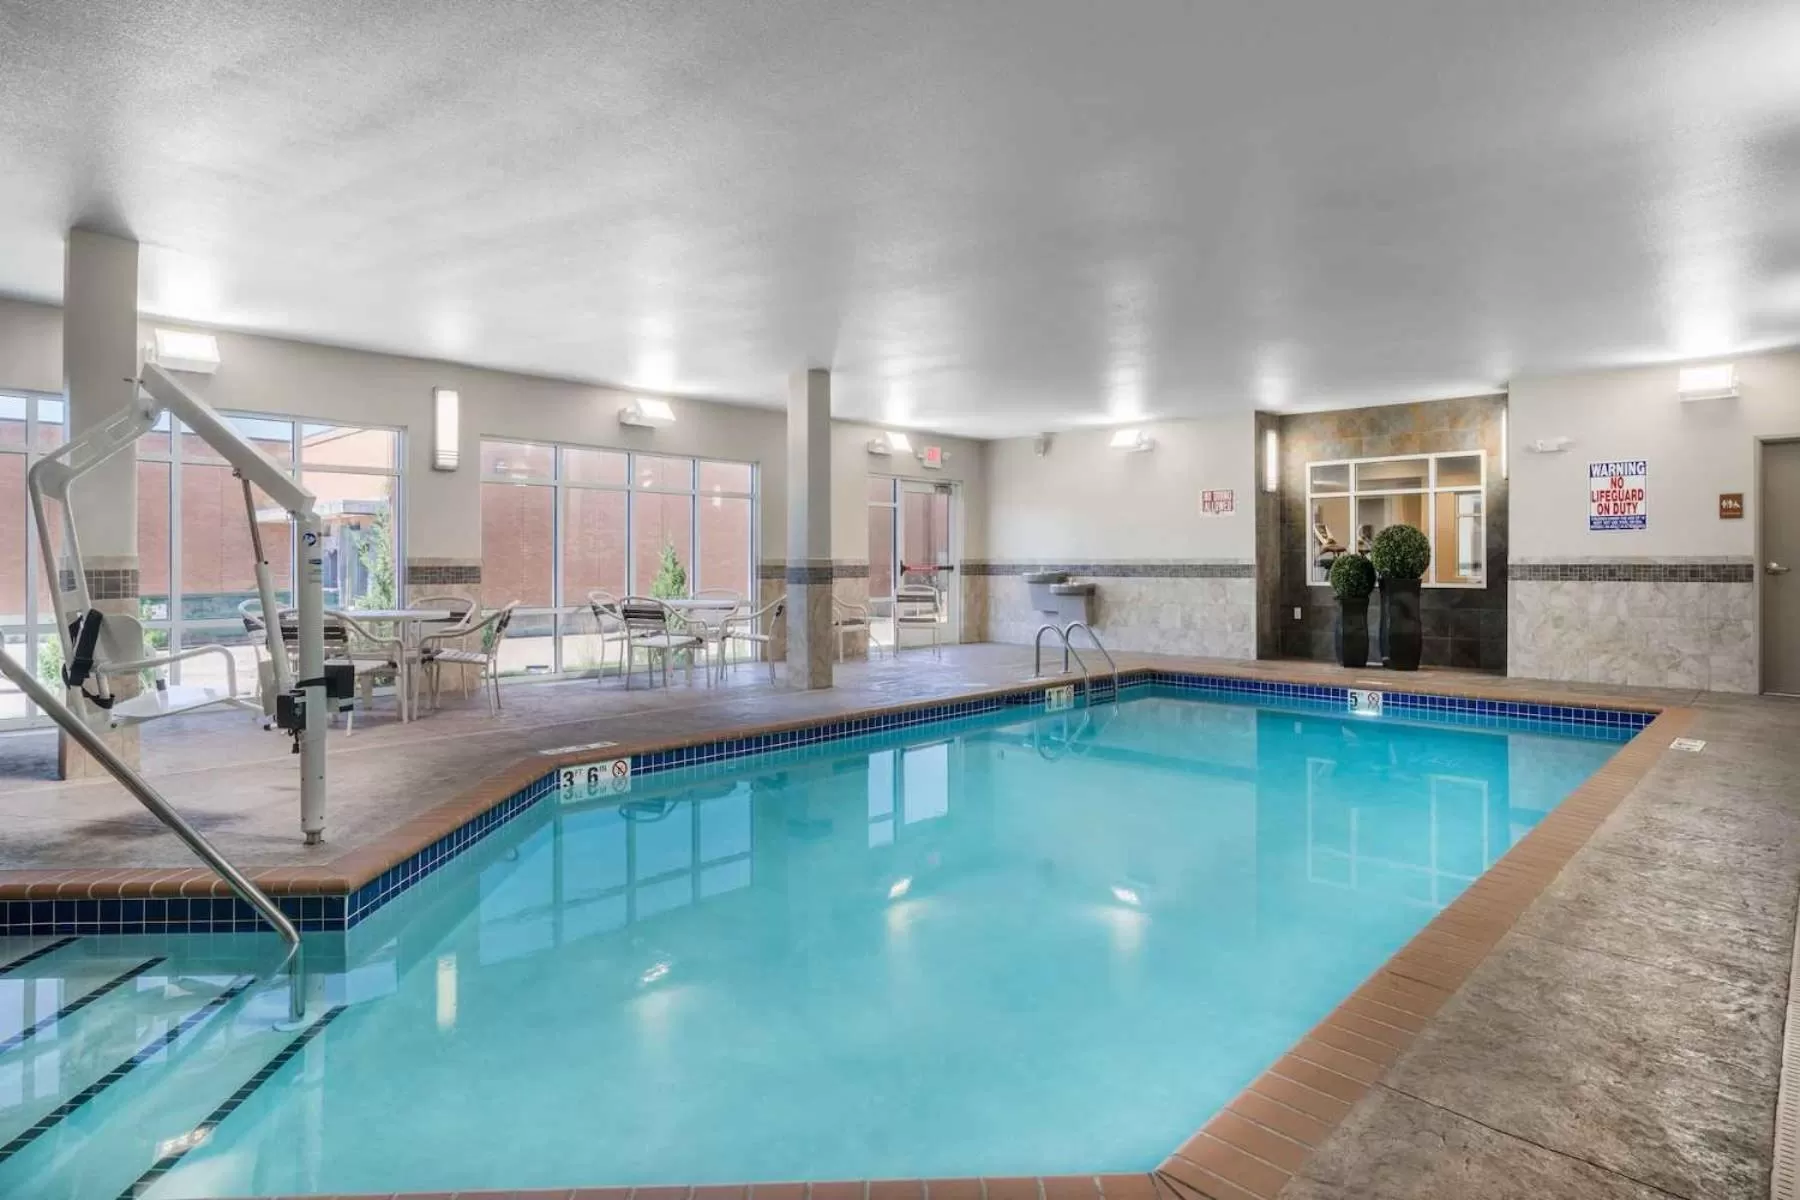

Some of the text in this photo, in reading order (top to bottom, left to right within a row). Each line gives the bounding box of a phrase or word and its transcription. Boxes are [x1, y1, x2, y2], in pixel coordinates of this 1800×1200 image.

[1591, 461, 1646, 477] WARNING
[1610, 476, 1624, 489] NO
[1591, 488, 1644, 502] LIFEGUARD
[1596, 502, 1638, 515] ON DUTY
[1350, 692, 1358, 706] 5
[563, 771, 574, 787] 3
[587, 767, 598, 784] 6
